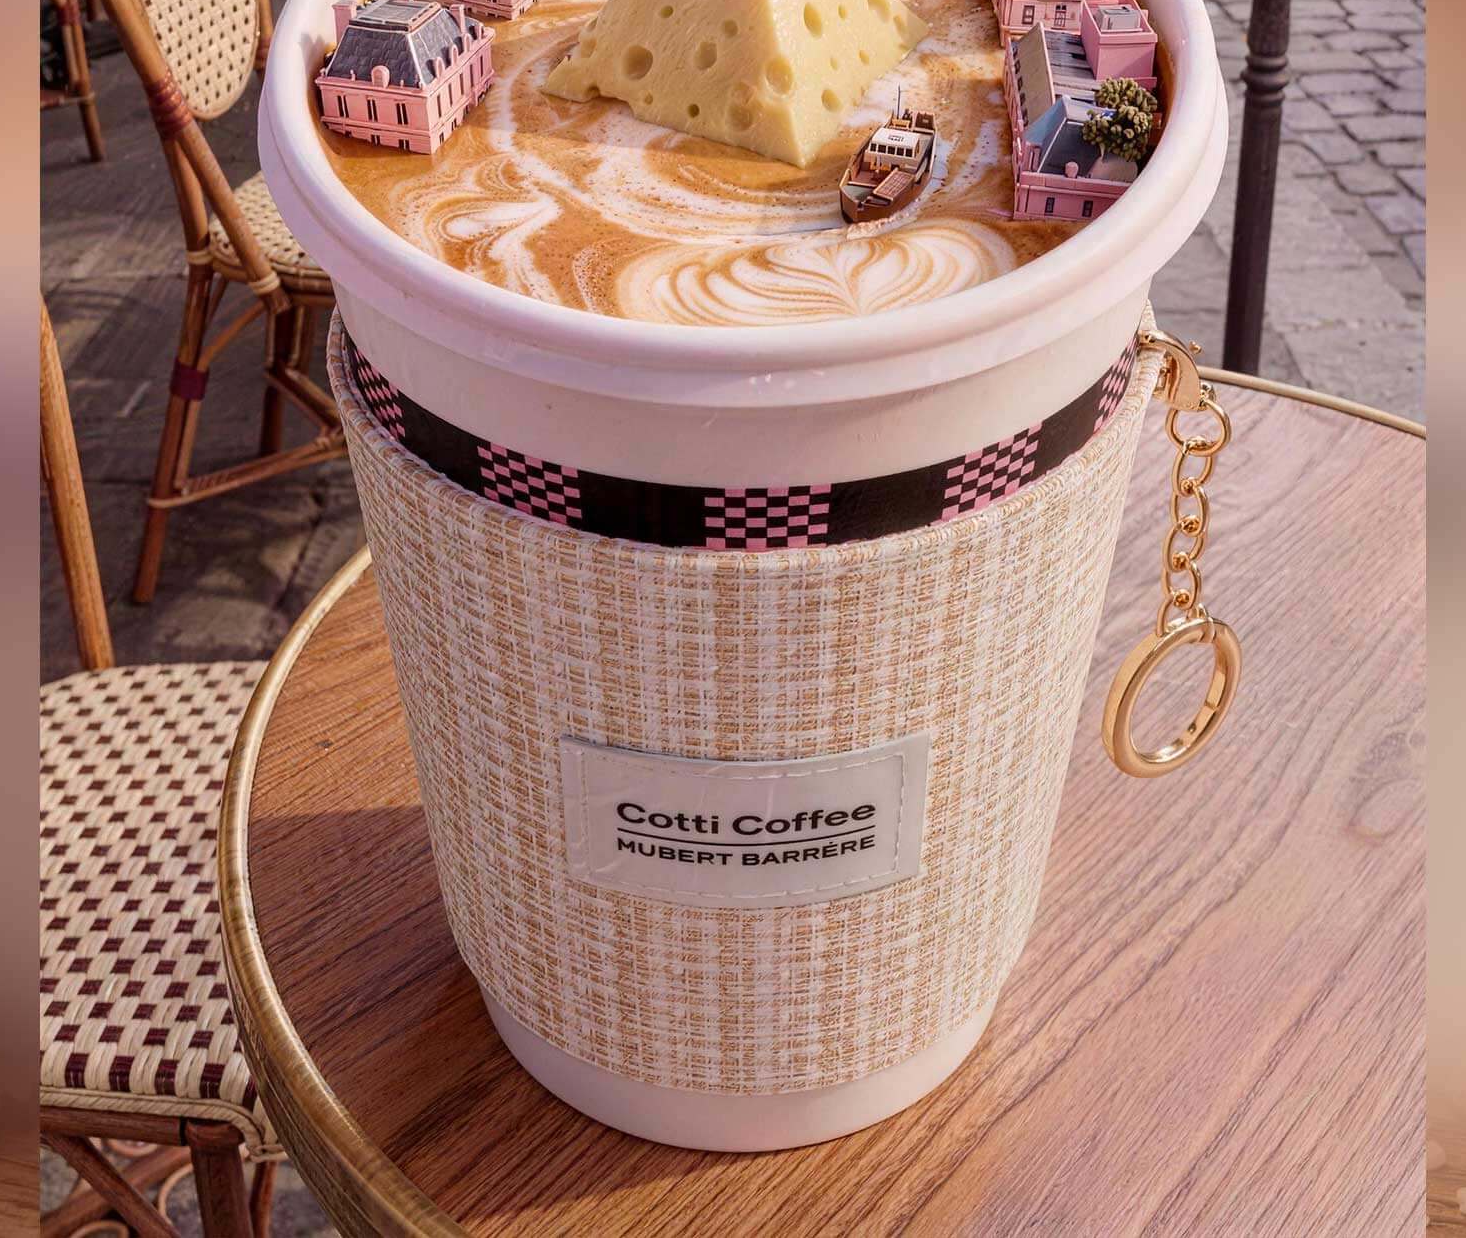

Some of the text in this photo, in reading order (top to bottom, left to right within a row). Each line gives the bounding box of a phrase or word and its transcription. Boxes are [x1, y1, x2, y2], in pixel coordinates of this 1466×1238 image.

[616, 802, 876, 836] Cotti Coffee
[617, 837, 733, 865] MUBERT
